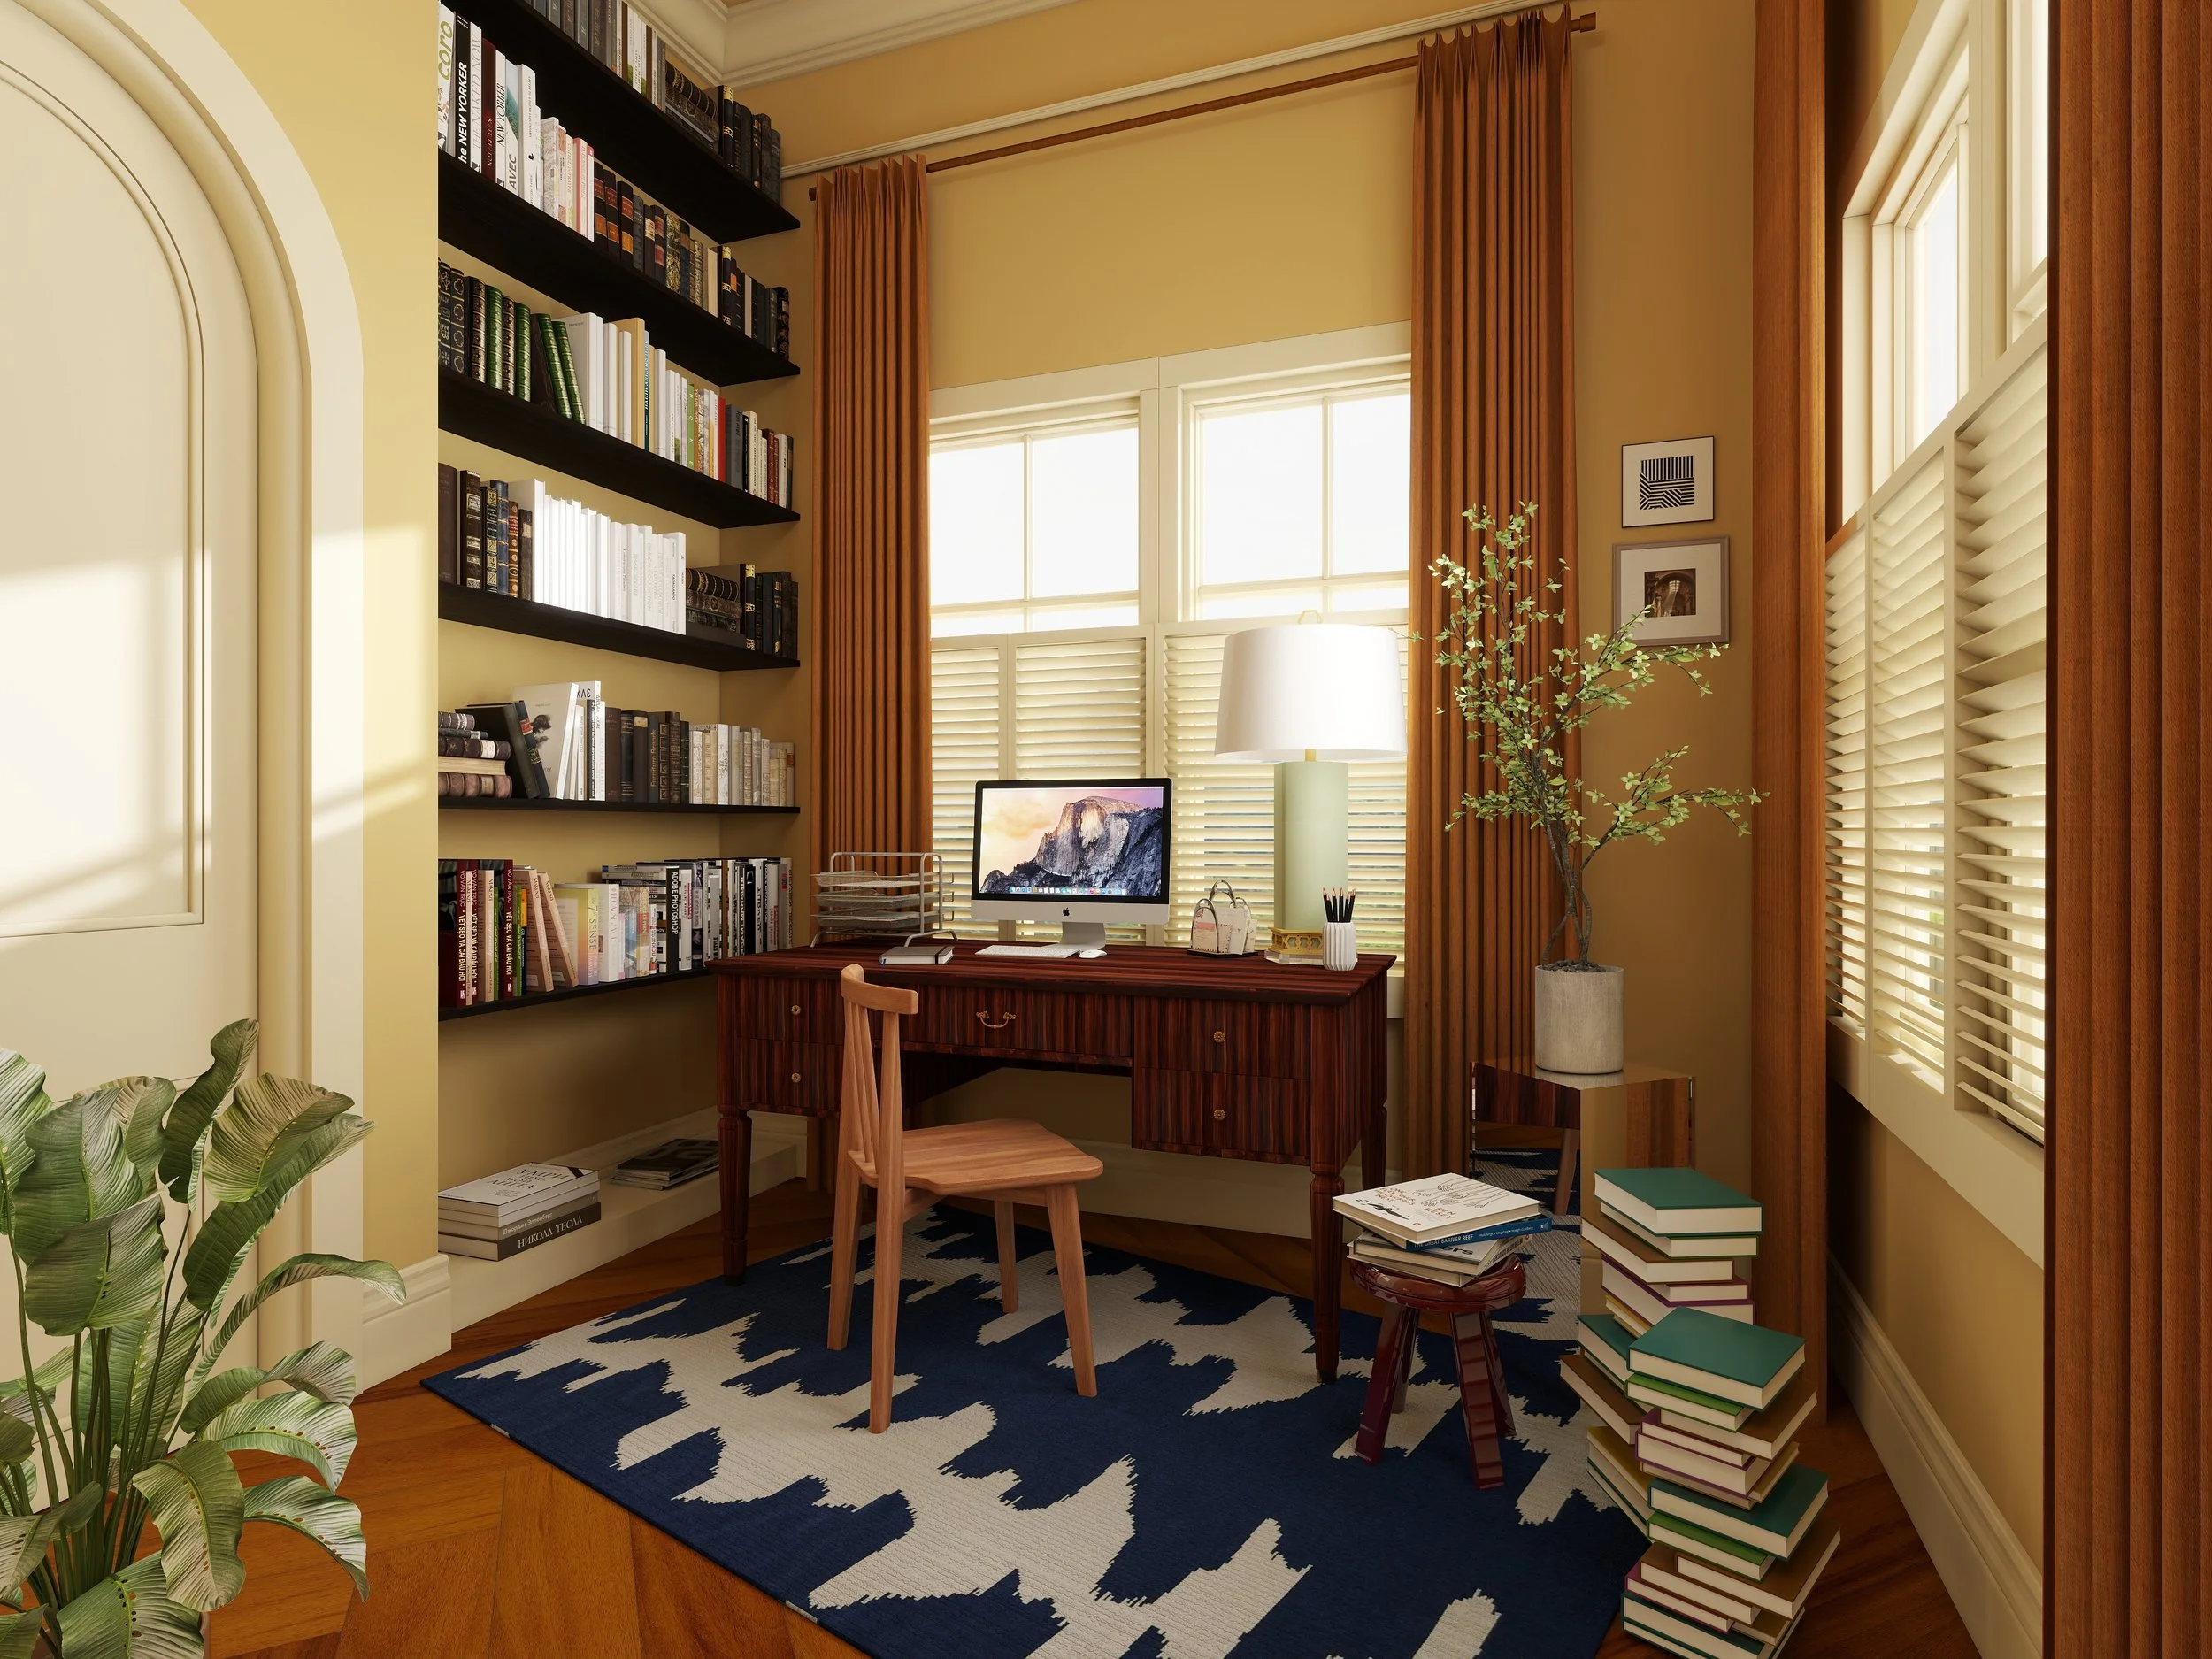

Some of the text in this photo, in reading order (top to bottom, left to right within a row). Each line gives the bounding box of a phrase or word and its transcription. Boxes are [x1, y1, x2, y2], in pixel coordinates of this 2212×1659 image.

[472, 34, 481, 68] NOW
[458, 61, 467, 113] YORKER
[472, 74, 481, 123] NAKED
[458, 114, 467, 146] NEW
[496, 83, 505, 148] NEW YORKER
[589, 918, 598, 950] SENSE
[518, 1216, 583, 1248] НИКОЛА ТЕСЛА
[1440, 1235, 1462, 1244] BARRIER
